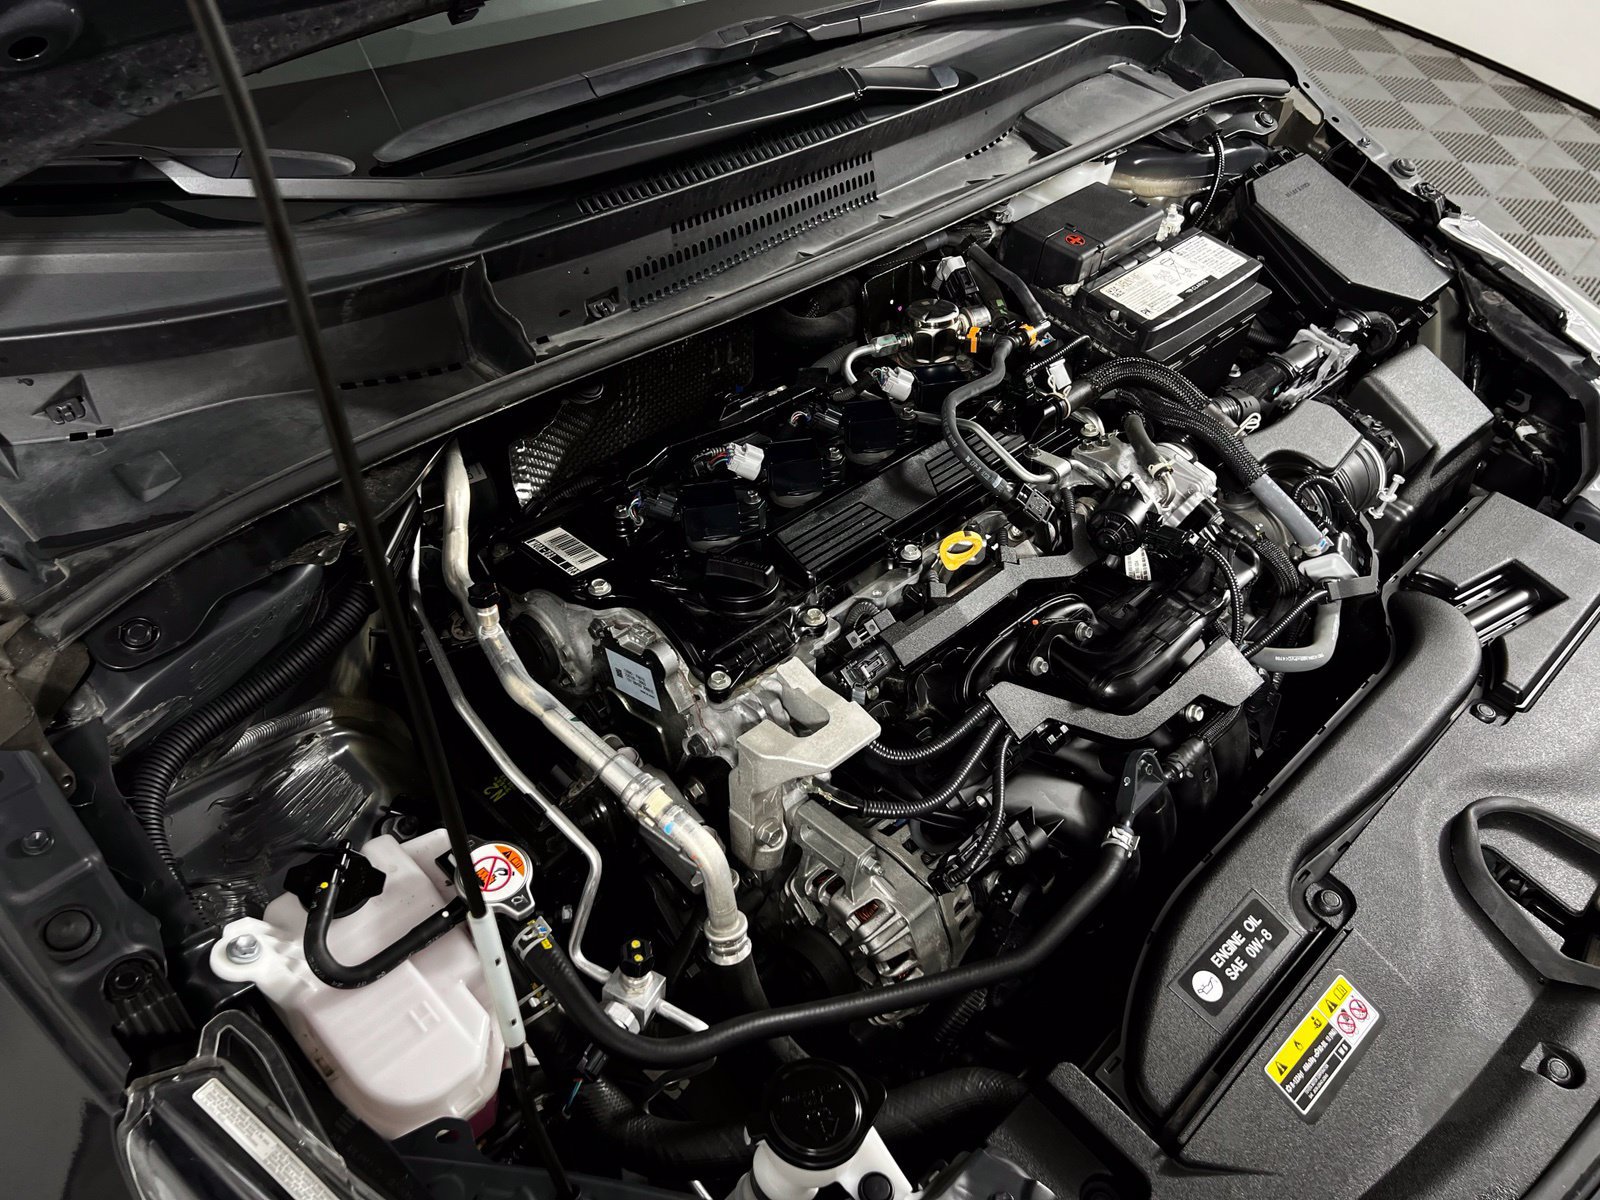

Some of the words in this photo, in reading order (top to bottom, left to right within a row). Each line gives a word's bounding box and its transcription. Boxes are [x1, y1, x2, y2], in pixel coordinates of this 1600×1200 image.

[1210, 930, 1246, 969] ENGINE
[1243, 914, 1263, 933] OIL
[1225, 956, 1248, 981] SAE
[1245, 928, 1273, 958] 0W-8
